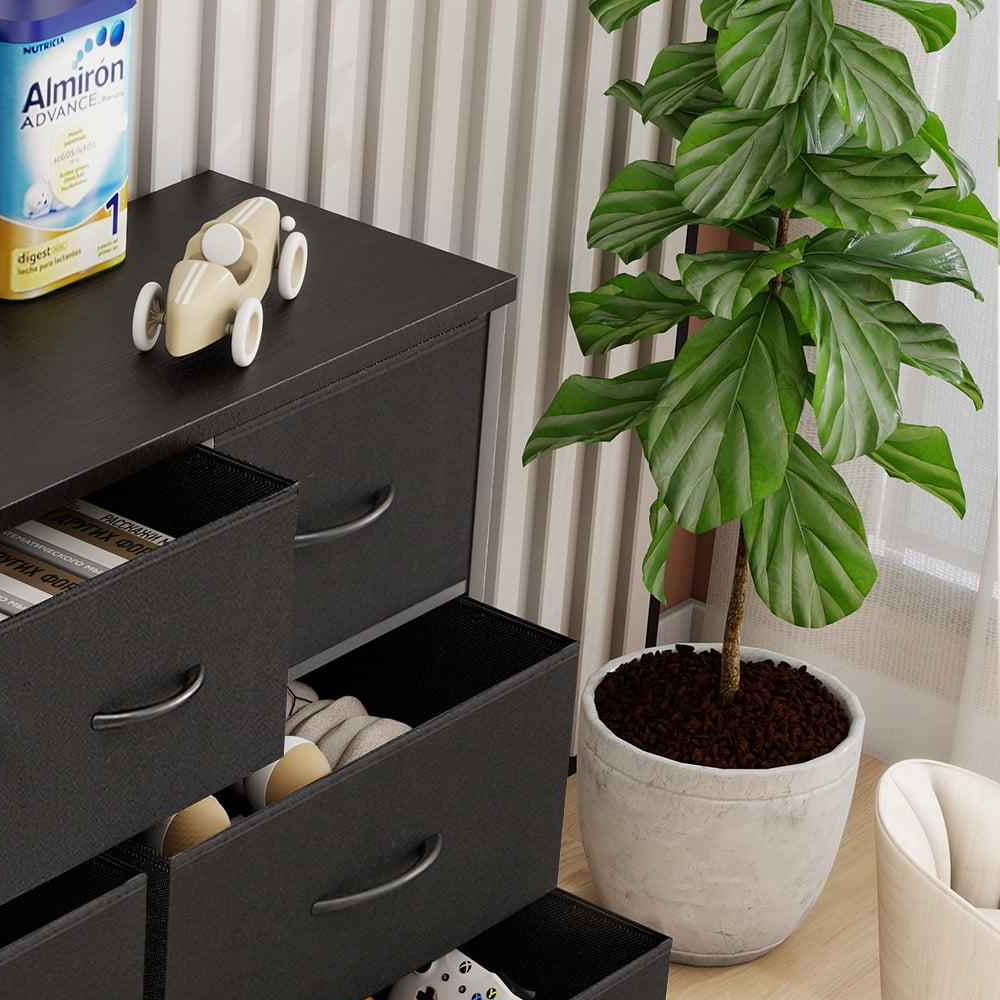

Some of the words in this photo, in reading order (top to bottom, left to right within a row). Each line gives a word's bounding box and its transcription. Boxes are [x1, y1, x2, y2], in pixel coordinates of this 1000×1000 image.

[23, 36, 64, 55] NUTRICIA
[21, 57, 124, 113] Almirón
[20, 93, 97, 130] ADVANCE
[106, 192, 119, 235] 1
[17, 247, 51, 266] digest
[39, 259, 53, 272] para
[54, 249, 82, 264] lactantes
[56, 513, 119, 542] ДРУГИХ
[100, 514, 161, 542] РАССКАЖИ
